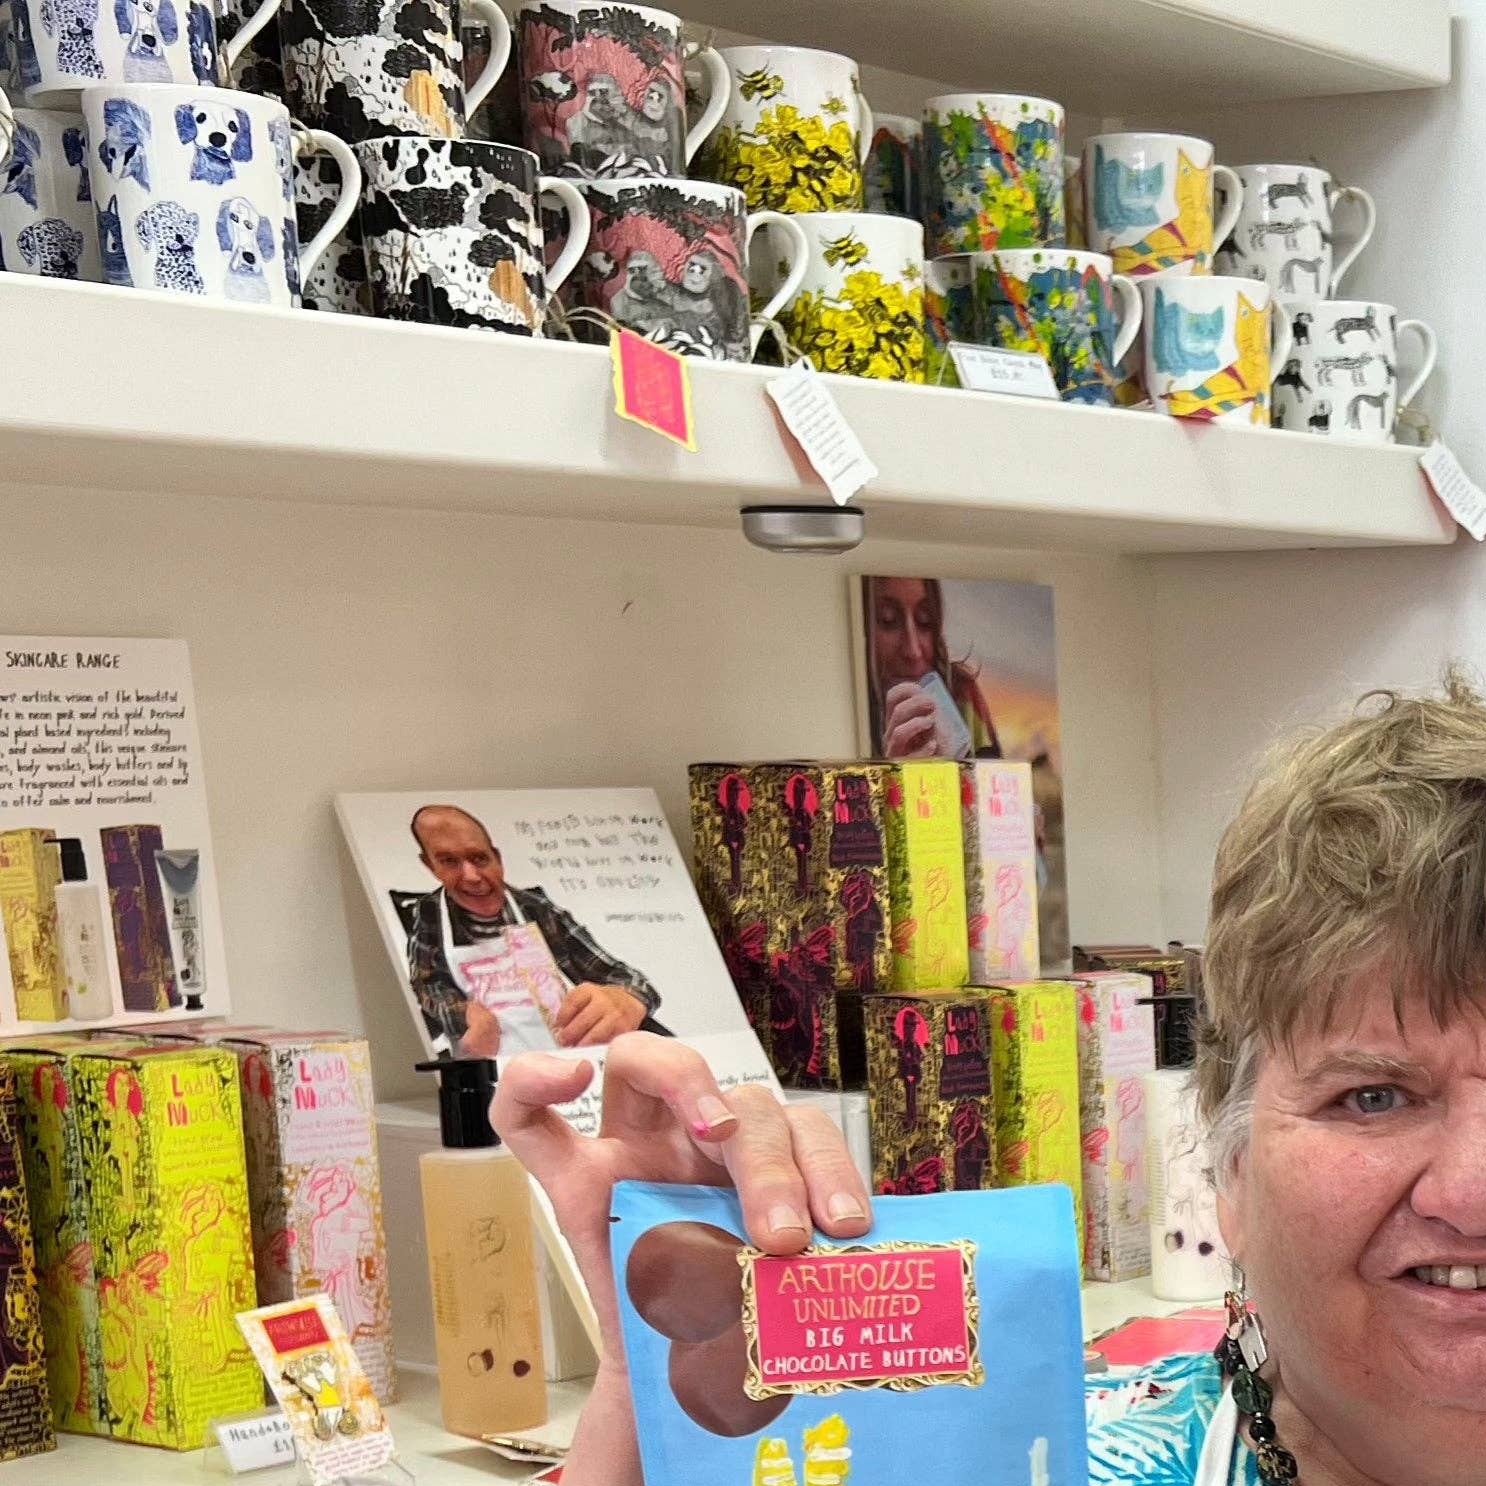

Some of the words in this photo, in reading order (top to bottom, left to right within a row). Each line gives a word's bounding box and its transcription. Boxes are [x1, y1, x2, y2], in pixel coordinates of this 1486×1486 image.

[6, 651, 69, 669] SKINCARE
[76, 652, 120, 669] RANGE
[299, 1057, 348, 1083] Lady
[171, 1072, 217, 1099] Lady
[777, 1258, 937, 1295] ARTHOUSE
[791, 1293, 921, 1324] UNLIMITED
[806, 1326, 845, 1348] BIG
[859, 1322, 915, 1346] MILK
[762, 1352, 874, 1376] CHOCOLATE
[882, 1344, 968, 1368] BUTTONS
